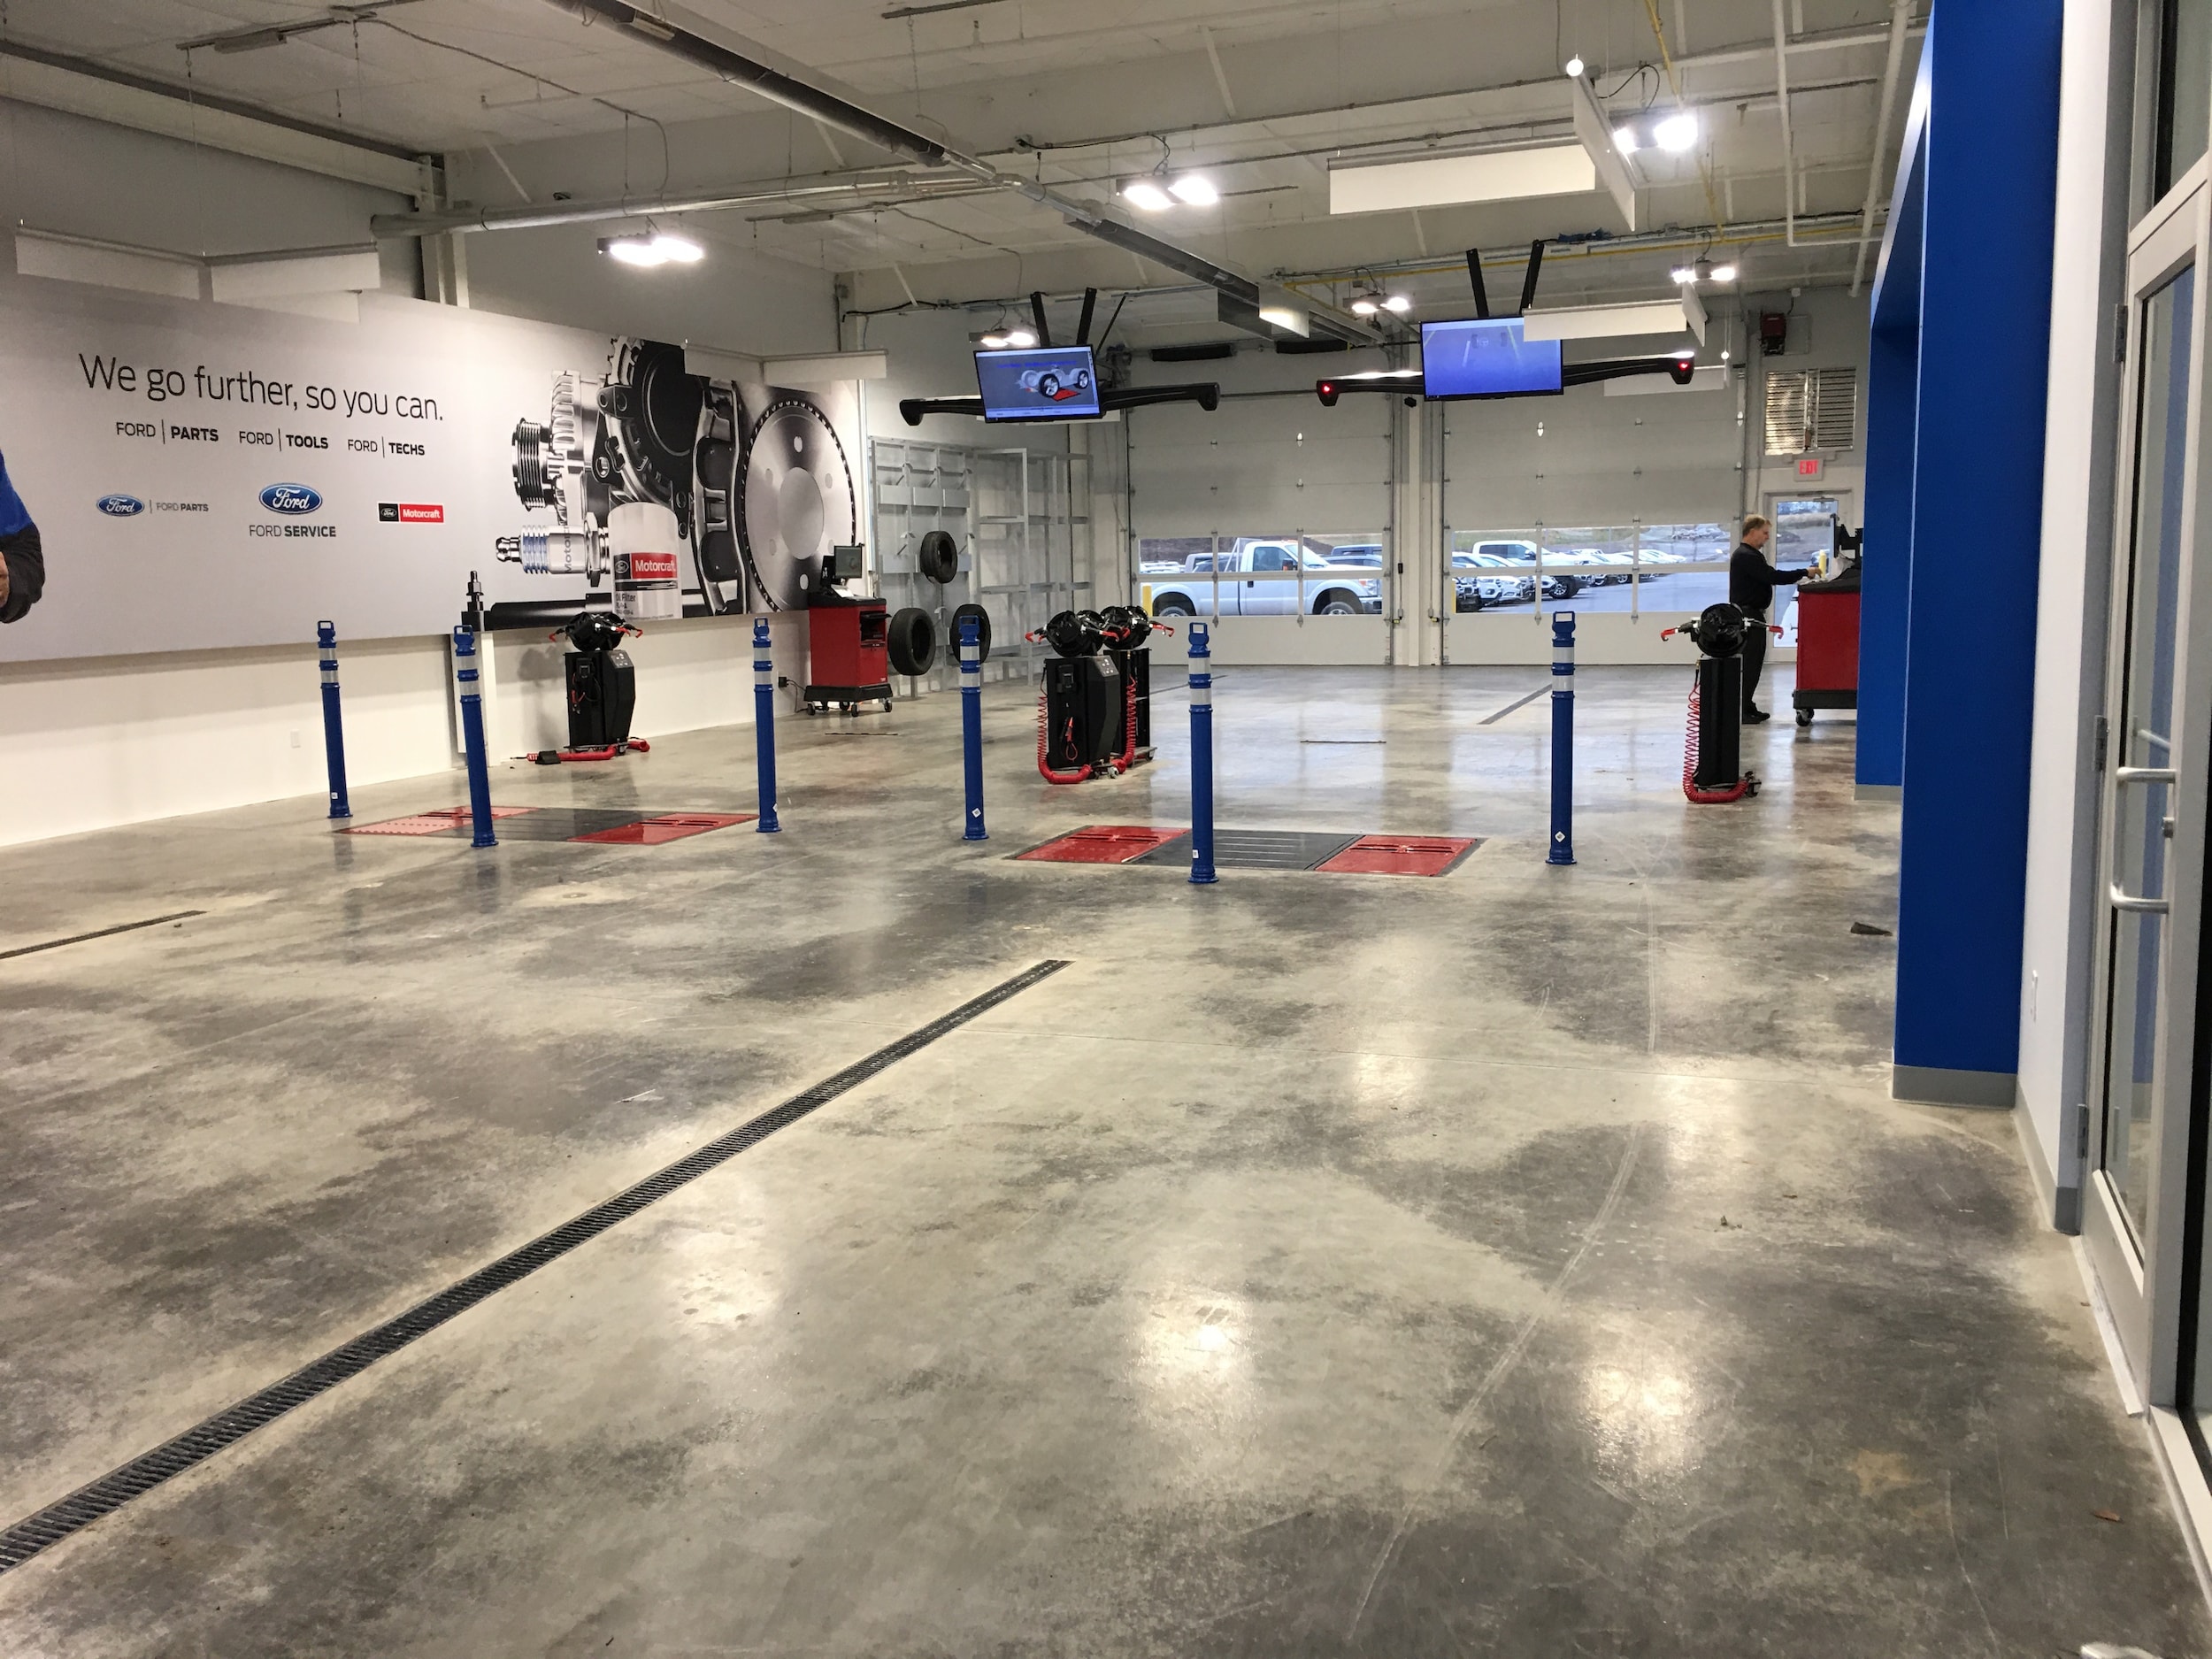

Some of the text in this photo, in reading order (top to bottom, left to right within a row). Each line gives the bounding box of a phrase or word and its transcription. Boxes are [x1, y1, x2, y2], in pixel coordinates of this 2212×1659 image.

[79, 353, 443, 421] We go further, so you can.
[116, 422, 219, 442] FORD PARTS
[239, 430, 329, 449] FORD TOOLS
[348, 439, 426, 456] FORD TECHS
[1799, 459, 1818, 475] EXIT
[106, 497, 209, 512] Ford FORD PARTS
[273, 488, 311, 510] Ford
[403, 509, 441, 518] Motorcraft
[249, 525, 336, 537] FORD SERVICE
